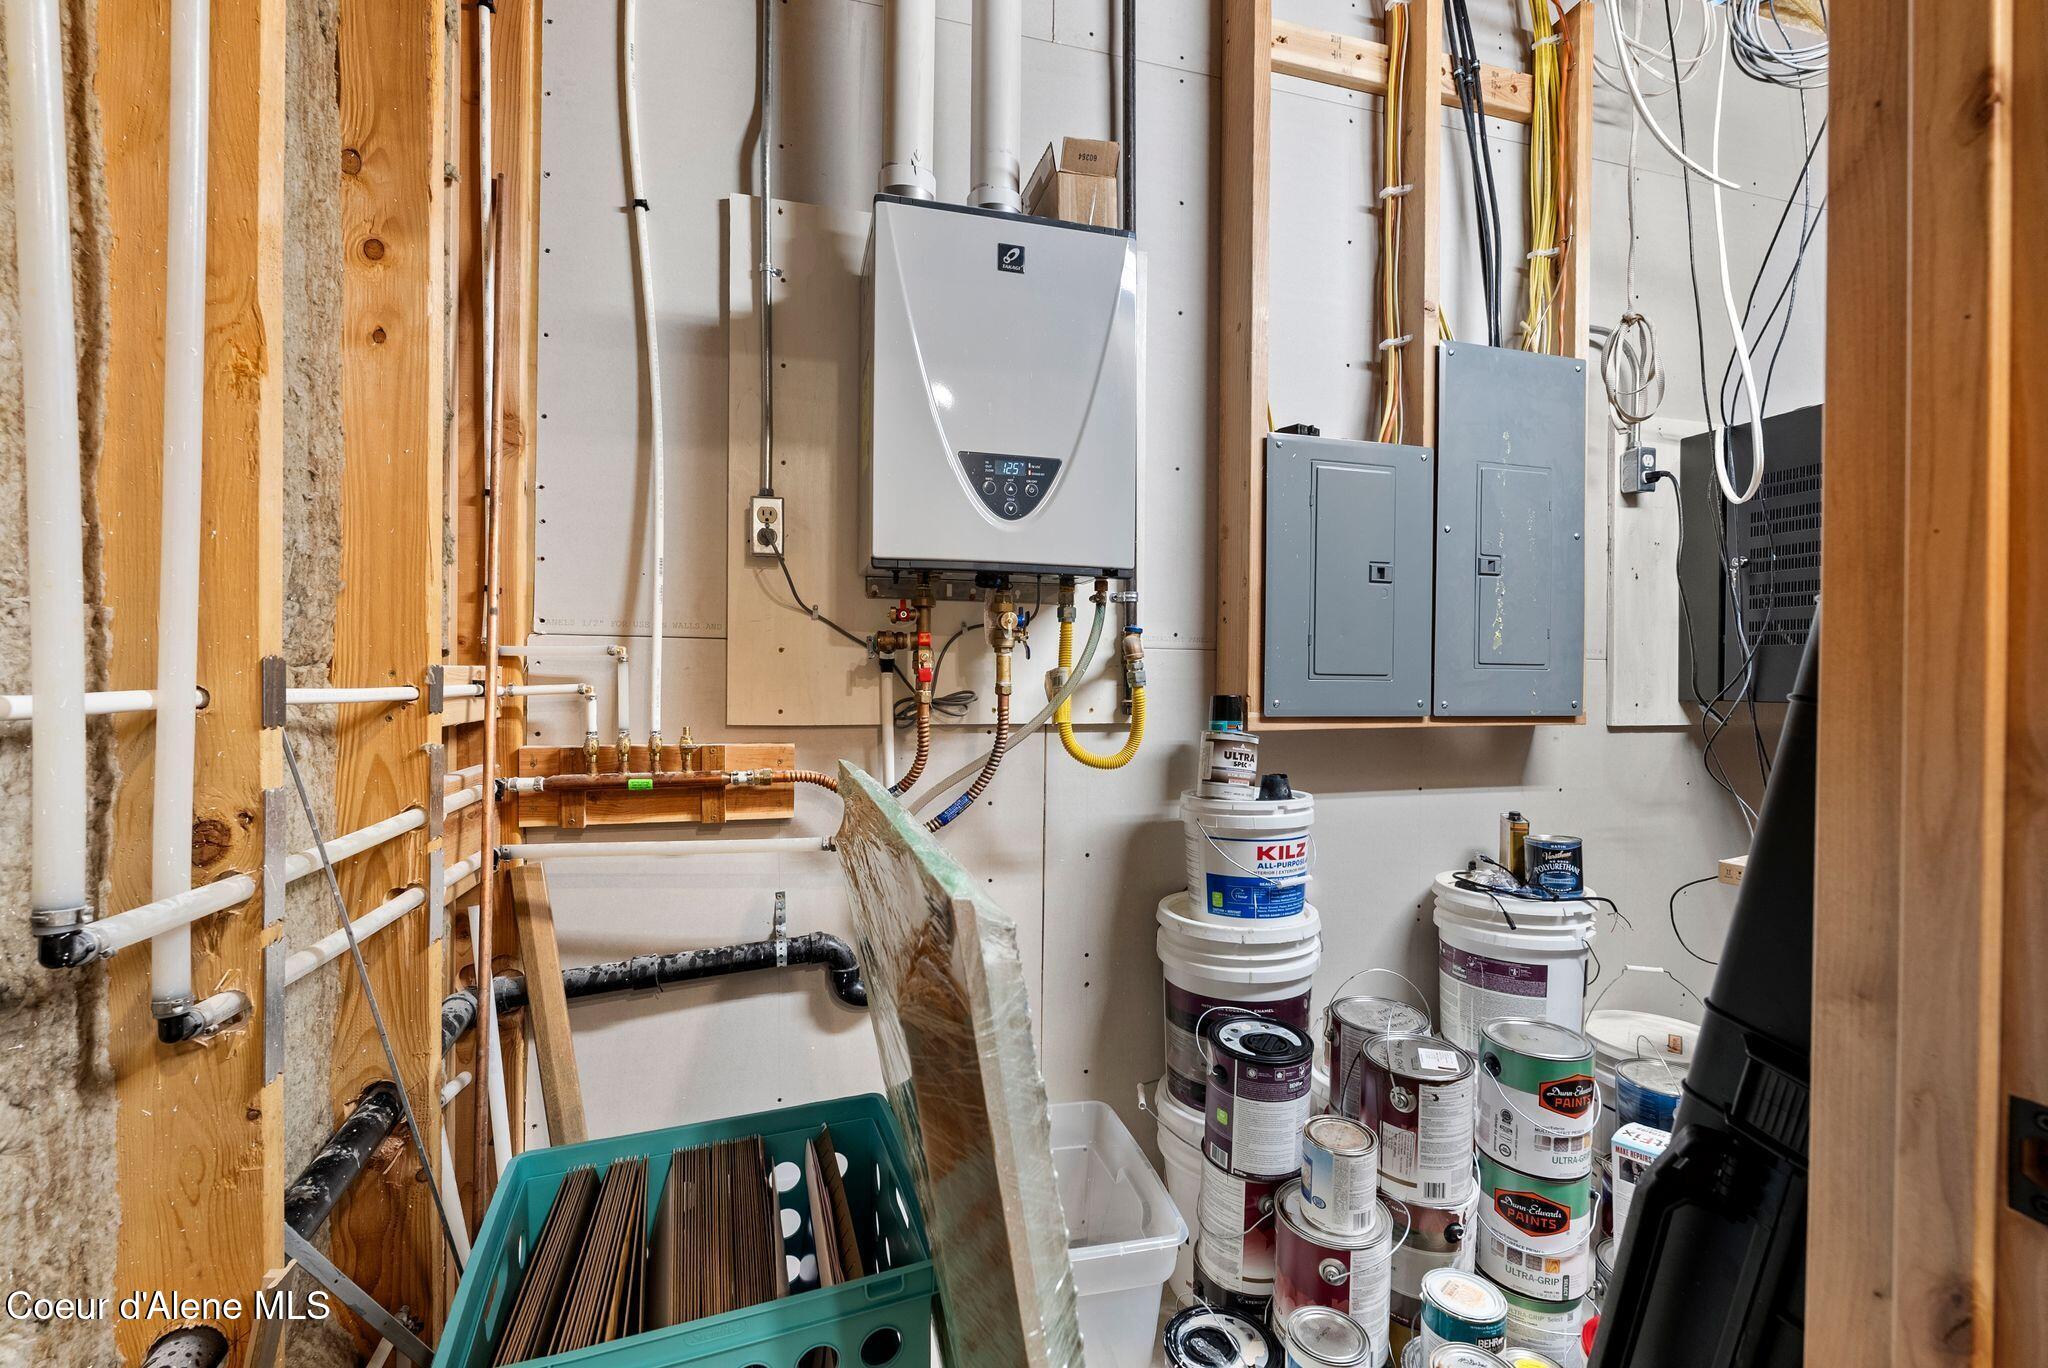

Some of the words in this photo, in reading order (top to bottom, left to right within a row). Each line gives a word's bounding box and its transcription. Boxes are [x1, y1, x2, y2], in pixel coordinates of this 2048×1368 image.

[1224, 750, 1255, 763] ULTRA
[1256, 842, 1306, 861] KILZ
[1615, 1145, 1629, 1157] MAKE
[1500, 1195, 1562, 1219] Dunn-Edwards
[1507, 1208, 1557, 1229] PAINTS
[1505, 1264, 1560, 1286] ULTRA-GRIP
[1477, 1337, 1500, 1349] BEHR
